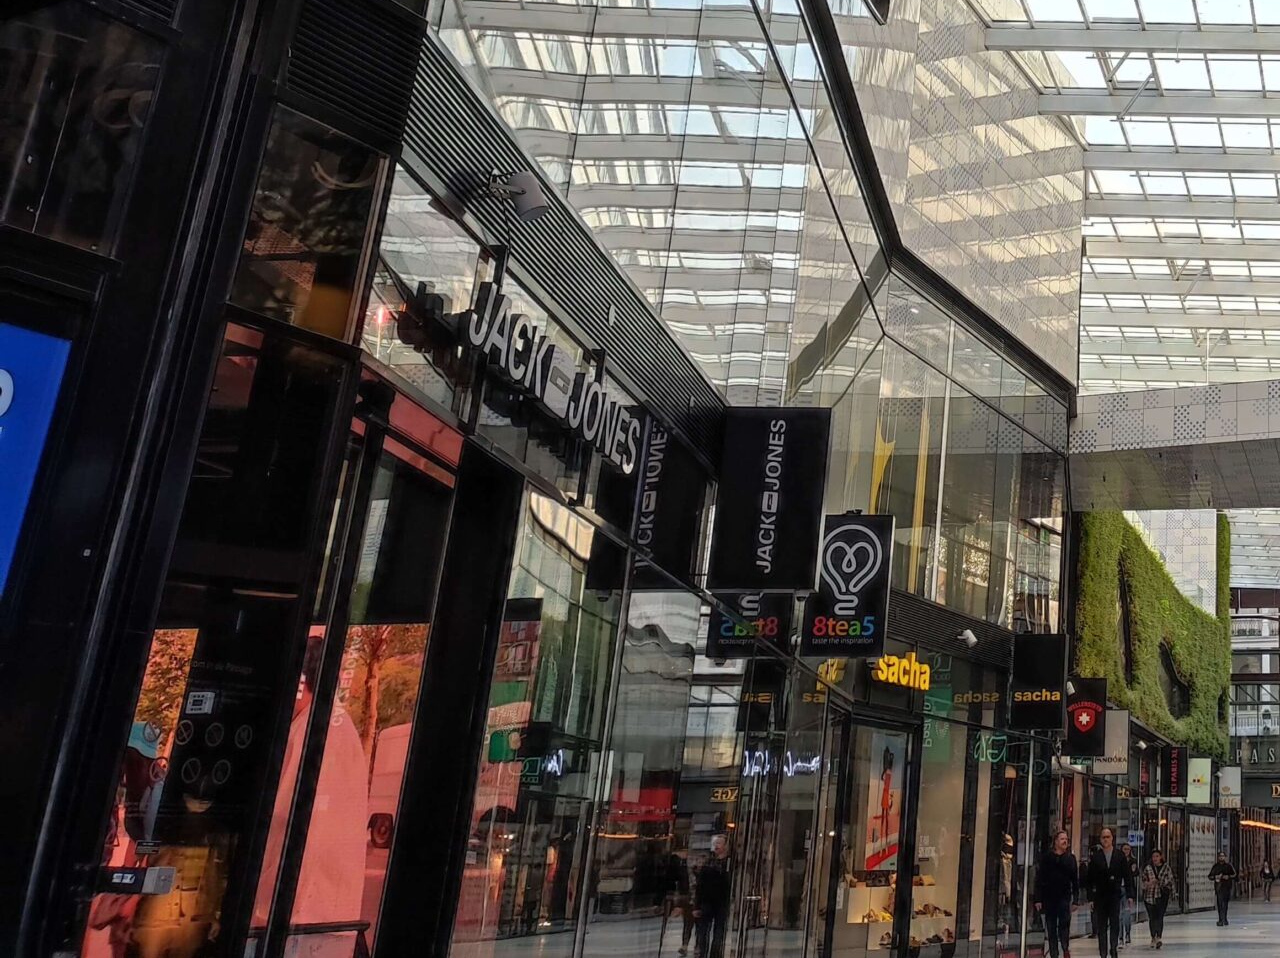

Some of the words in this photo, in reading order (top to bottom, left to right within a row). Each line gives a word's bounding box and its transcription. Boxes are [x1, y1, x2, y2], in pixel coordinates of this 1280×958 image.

[469, 282, 551, 399] JACK
[568, 378, 642, 475] JONES
[764, 419, 787, 490] JONES
[756, 514, 777, 574] JACK
[812, 616, 875, 637] 8tea5
[877, 652, 931, 691] sacha
[1014, 688, 1061, 702] sacha
[1171, 749, 1178, 759] XL
